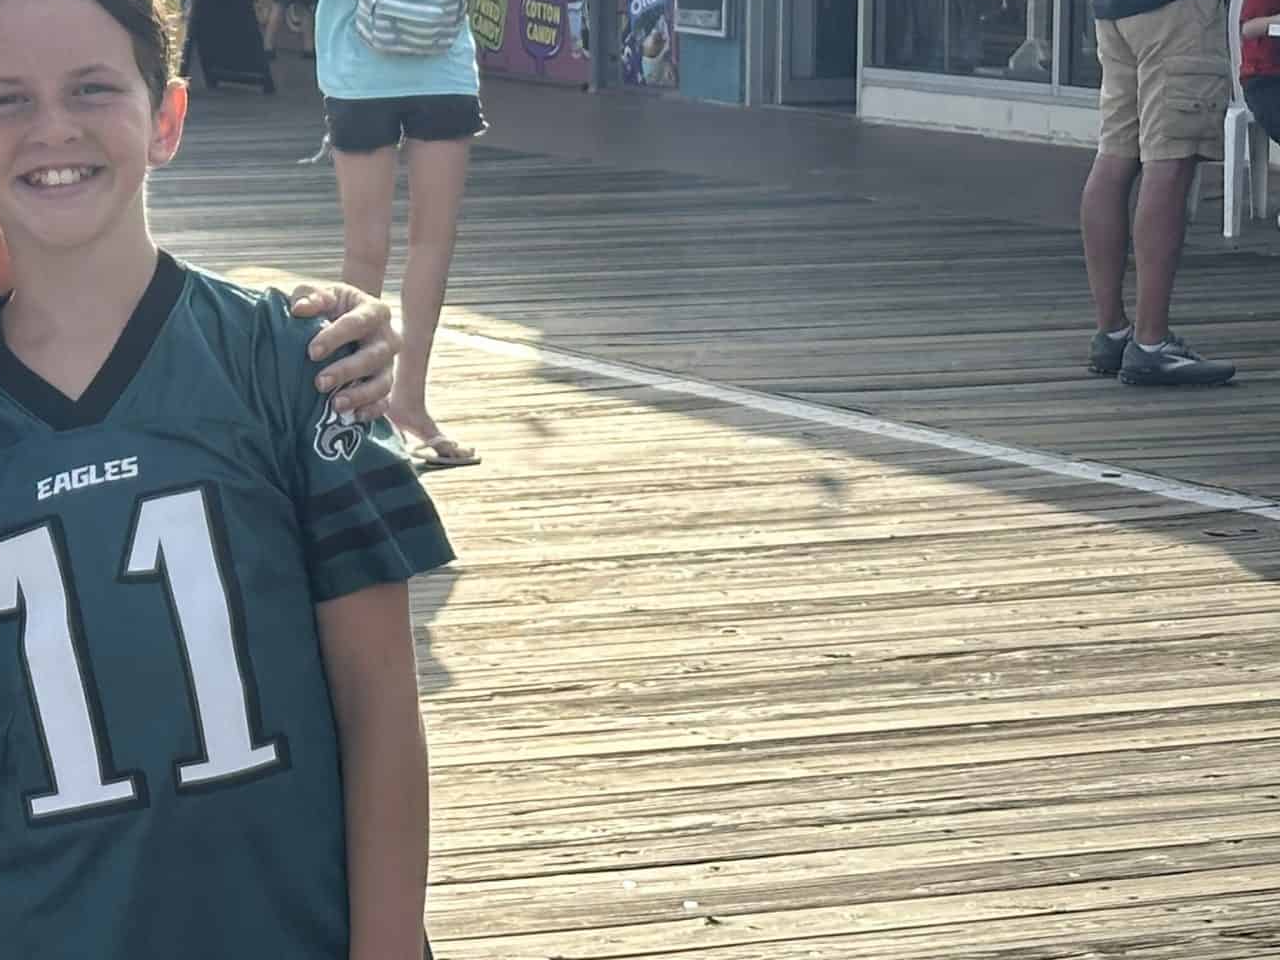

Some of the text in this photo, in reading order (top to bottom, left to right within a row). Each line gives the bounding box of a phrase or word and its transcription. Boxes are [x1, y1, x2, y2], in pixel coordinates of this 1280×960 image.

[525, 0, 561, 25] COTTON
[526, 23, 558, 47] CANDY
[36, 455, 140, 502] EAGLES
